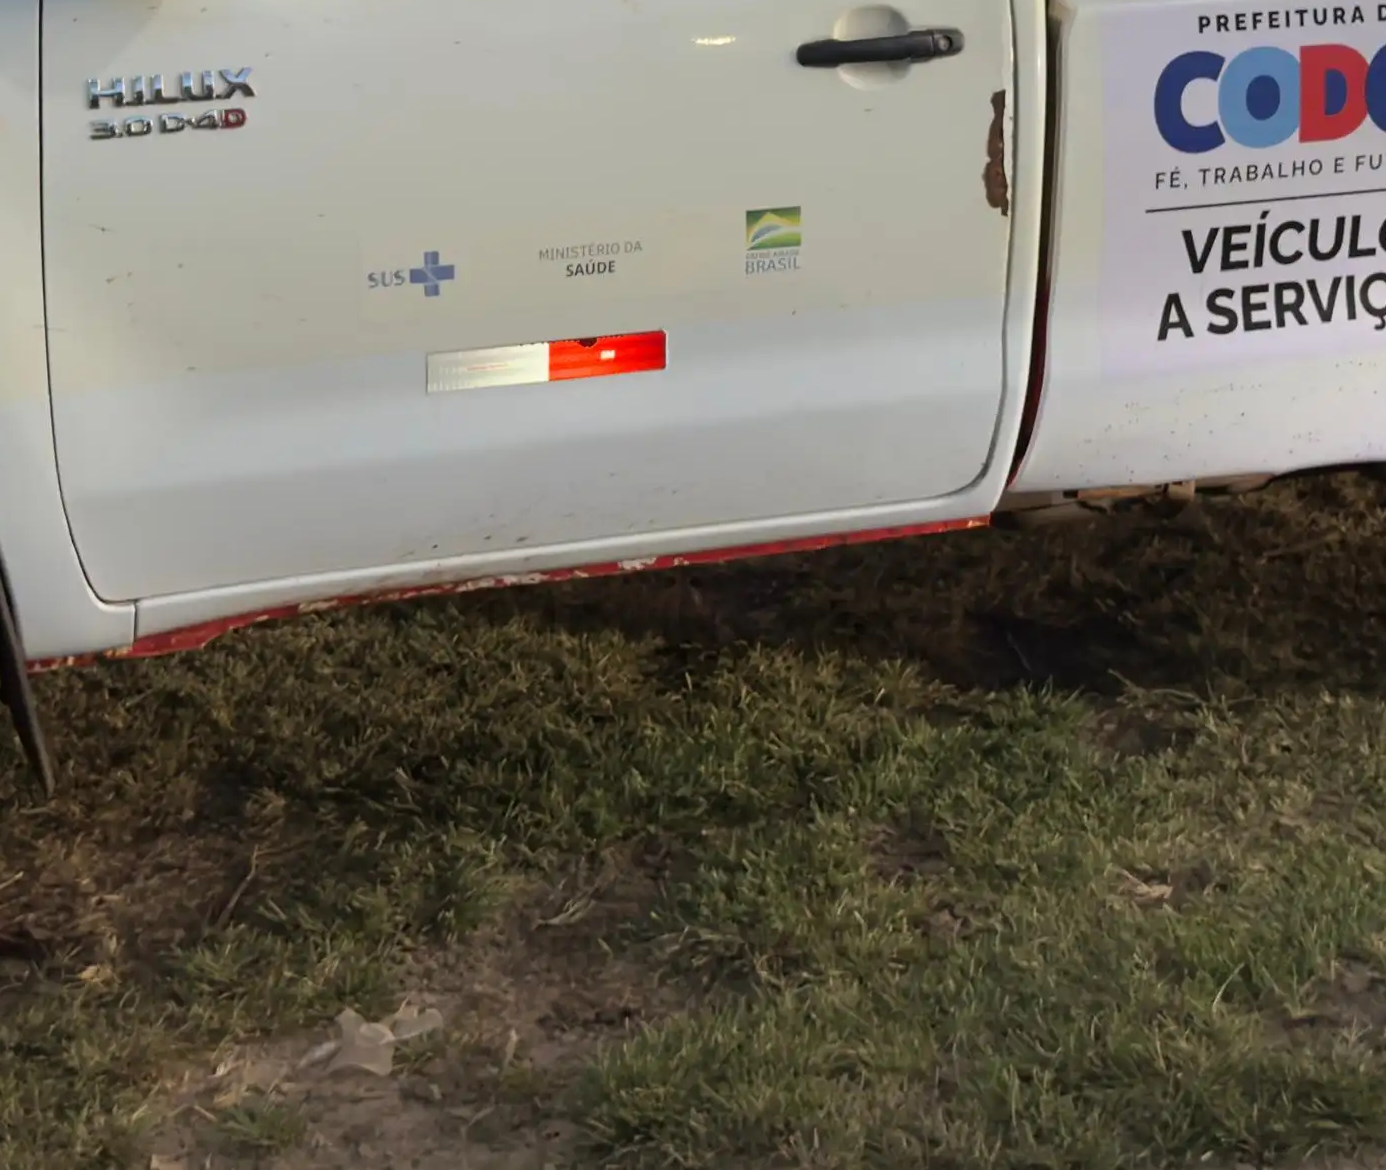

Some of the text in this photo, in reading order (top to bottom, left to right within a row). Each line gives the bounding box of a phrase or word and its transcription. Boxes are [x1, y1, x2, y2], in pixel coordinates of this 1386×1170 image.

[1198, 7, 1365, 34] PREFEITURA
[87, 67, 256, 109] HILUX
[90, 115, 153, 140] 3.0
[1155, 166, 1188, 190] FÉ,
[1199, 159, 1323, 187] TRABALHO
[1334, 157, 1345, 174] E
[539, 240, 642, 261] MINISTÉRIO DA
[566, 258, 616, 277] SAÚDE
[745, 257, 801, 275] BRASIL
[368, 270, 405, 289] SUS
[1157, 293, 1195, 342] A
